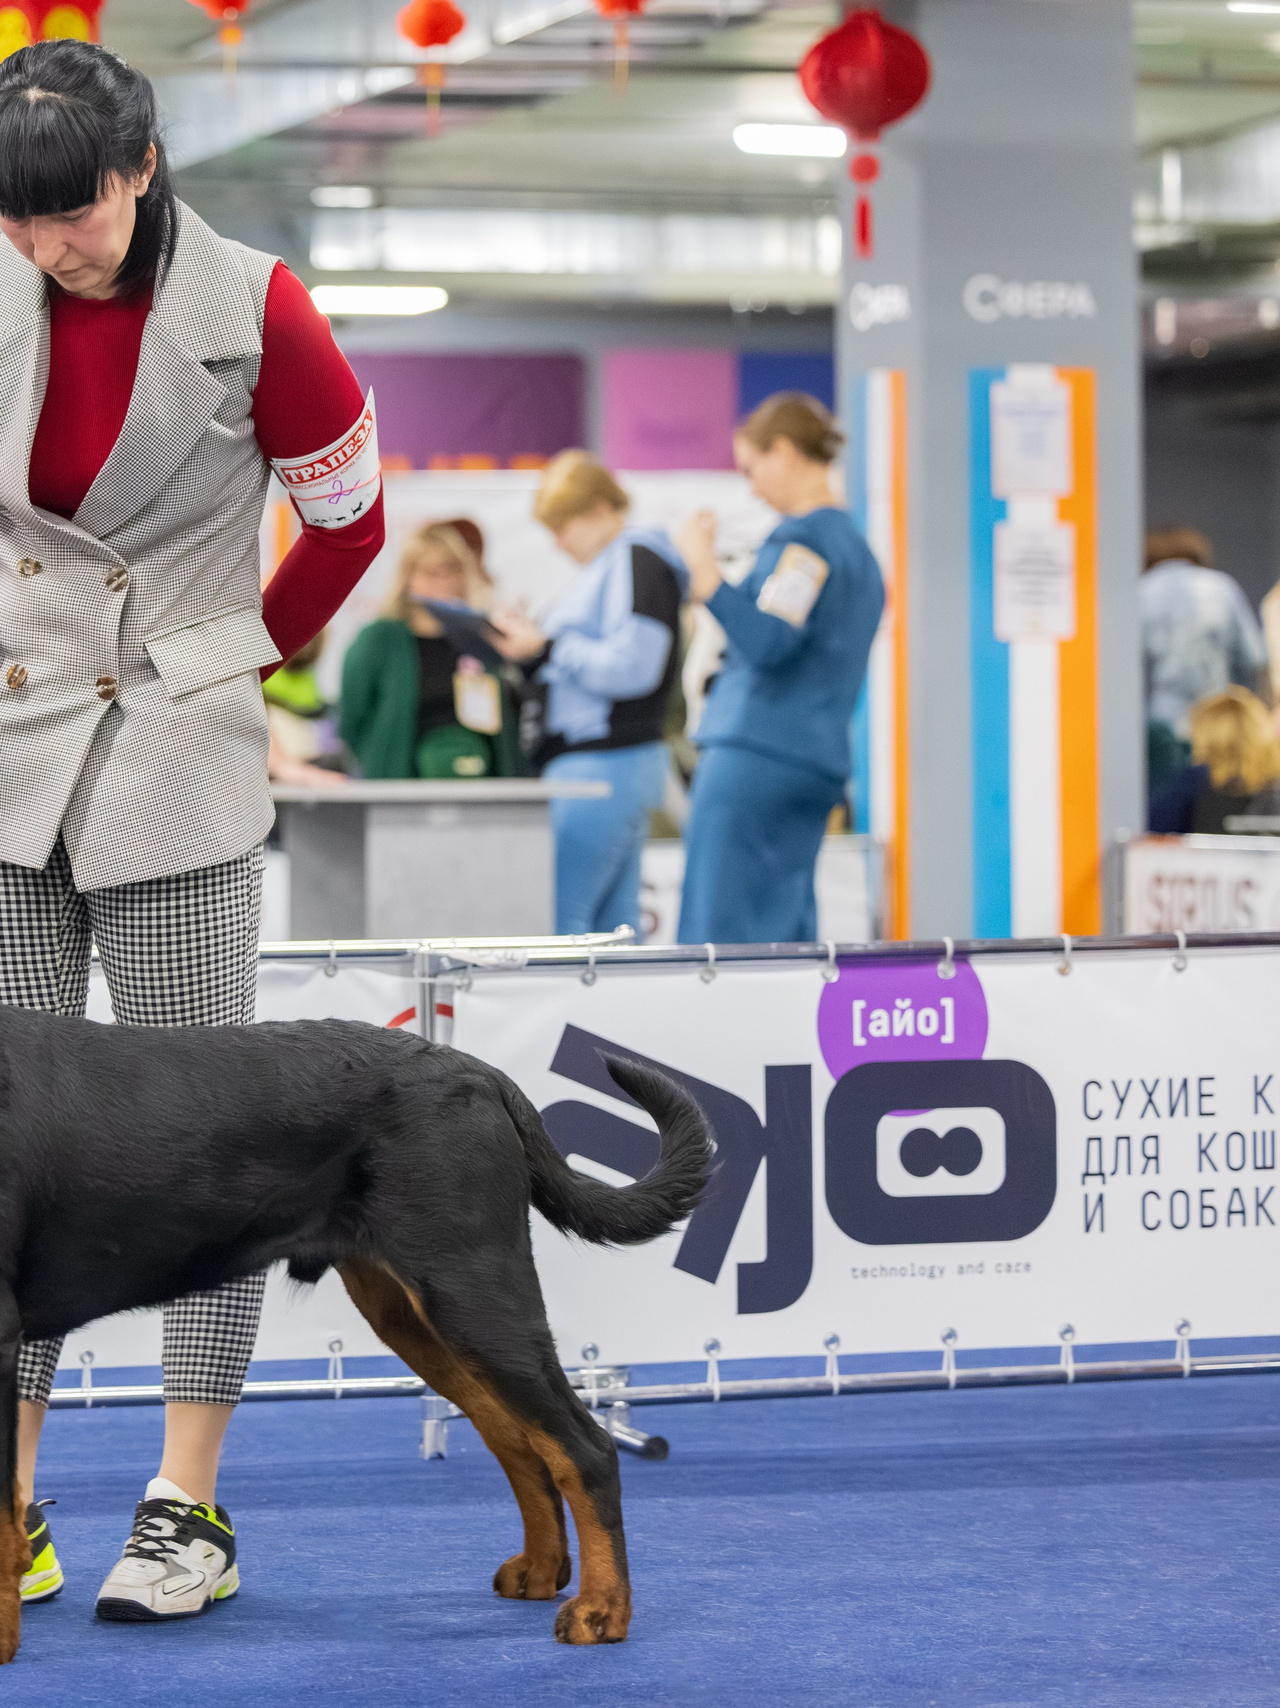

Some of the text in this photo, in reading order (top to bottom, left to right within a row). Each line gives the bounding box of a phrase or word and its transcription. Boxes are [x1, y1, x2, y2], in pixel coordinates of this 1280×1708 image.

[283, 418, 373, 482] ТРАПЕЗА
[852, 997, 955, 1046] [айо]
[1083, 1076, 1216, 1121] СУХИЕ
[1082, 1130, 1275, 1186] ДЛЯ КОШ
[1084, 1186, 1276, 1233] И СОБАК
[851, 1261, 1032, 1279] technology and care
